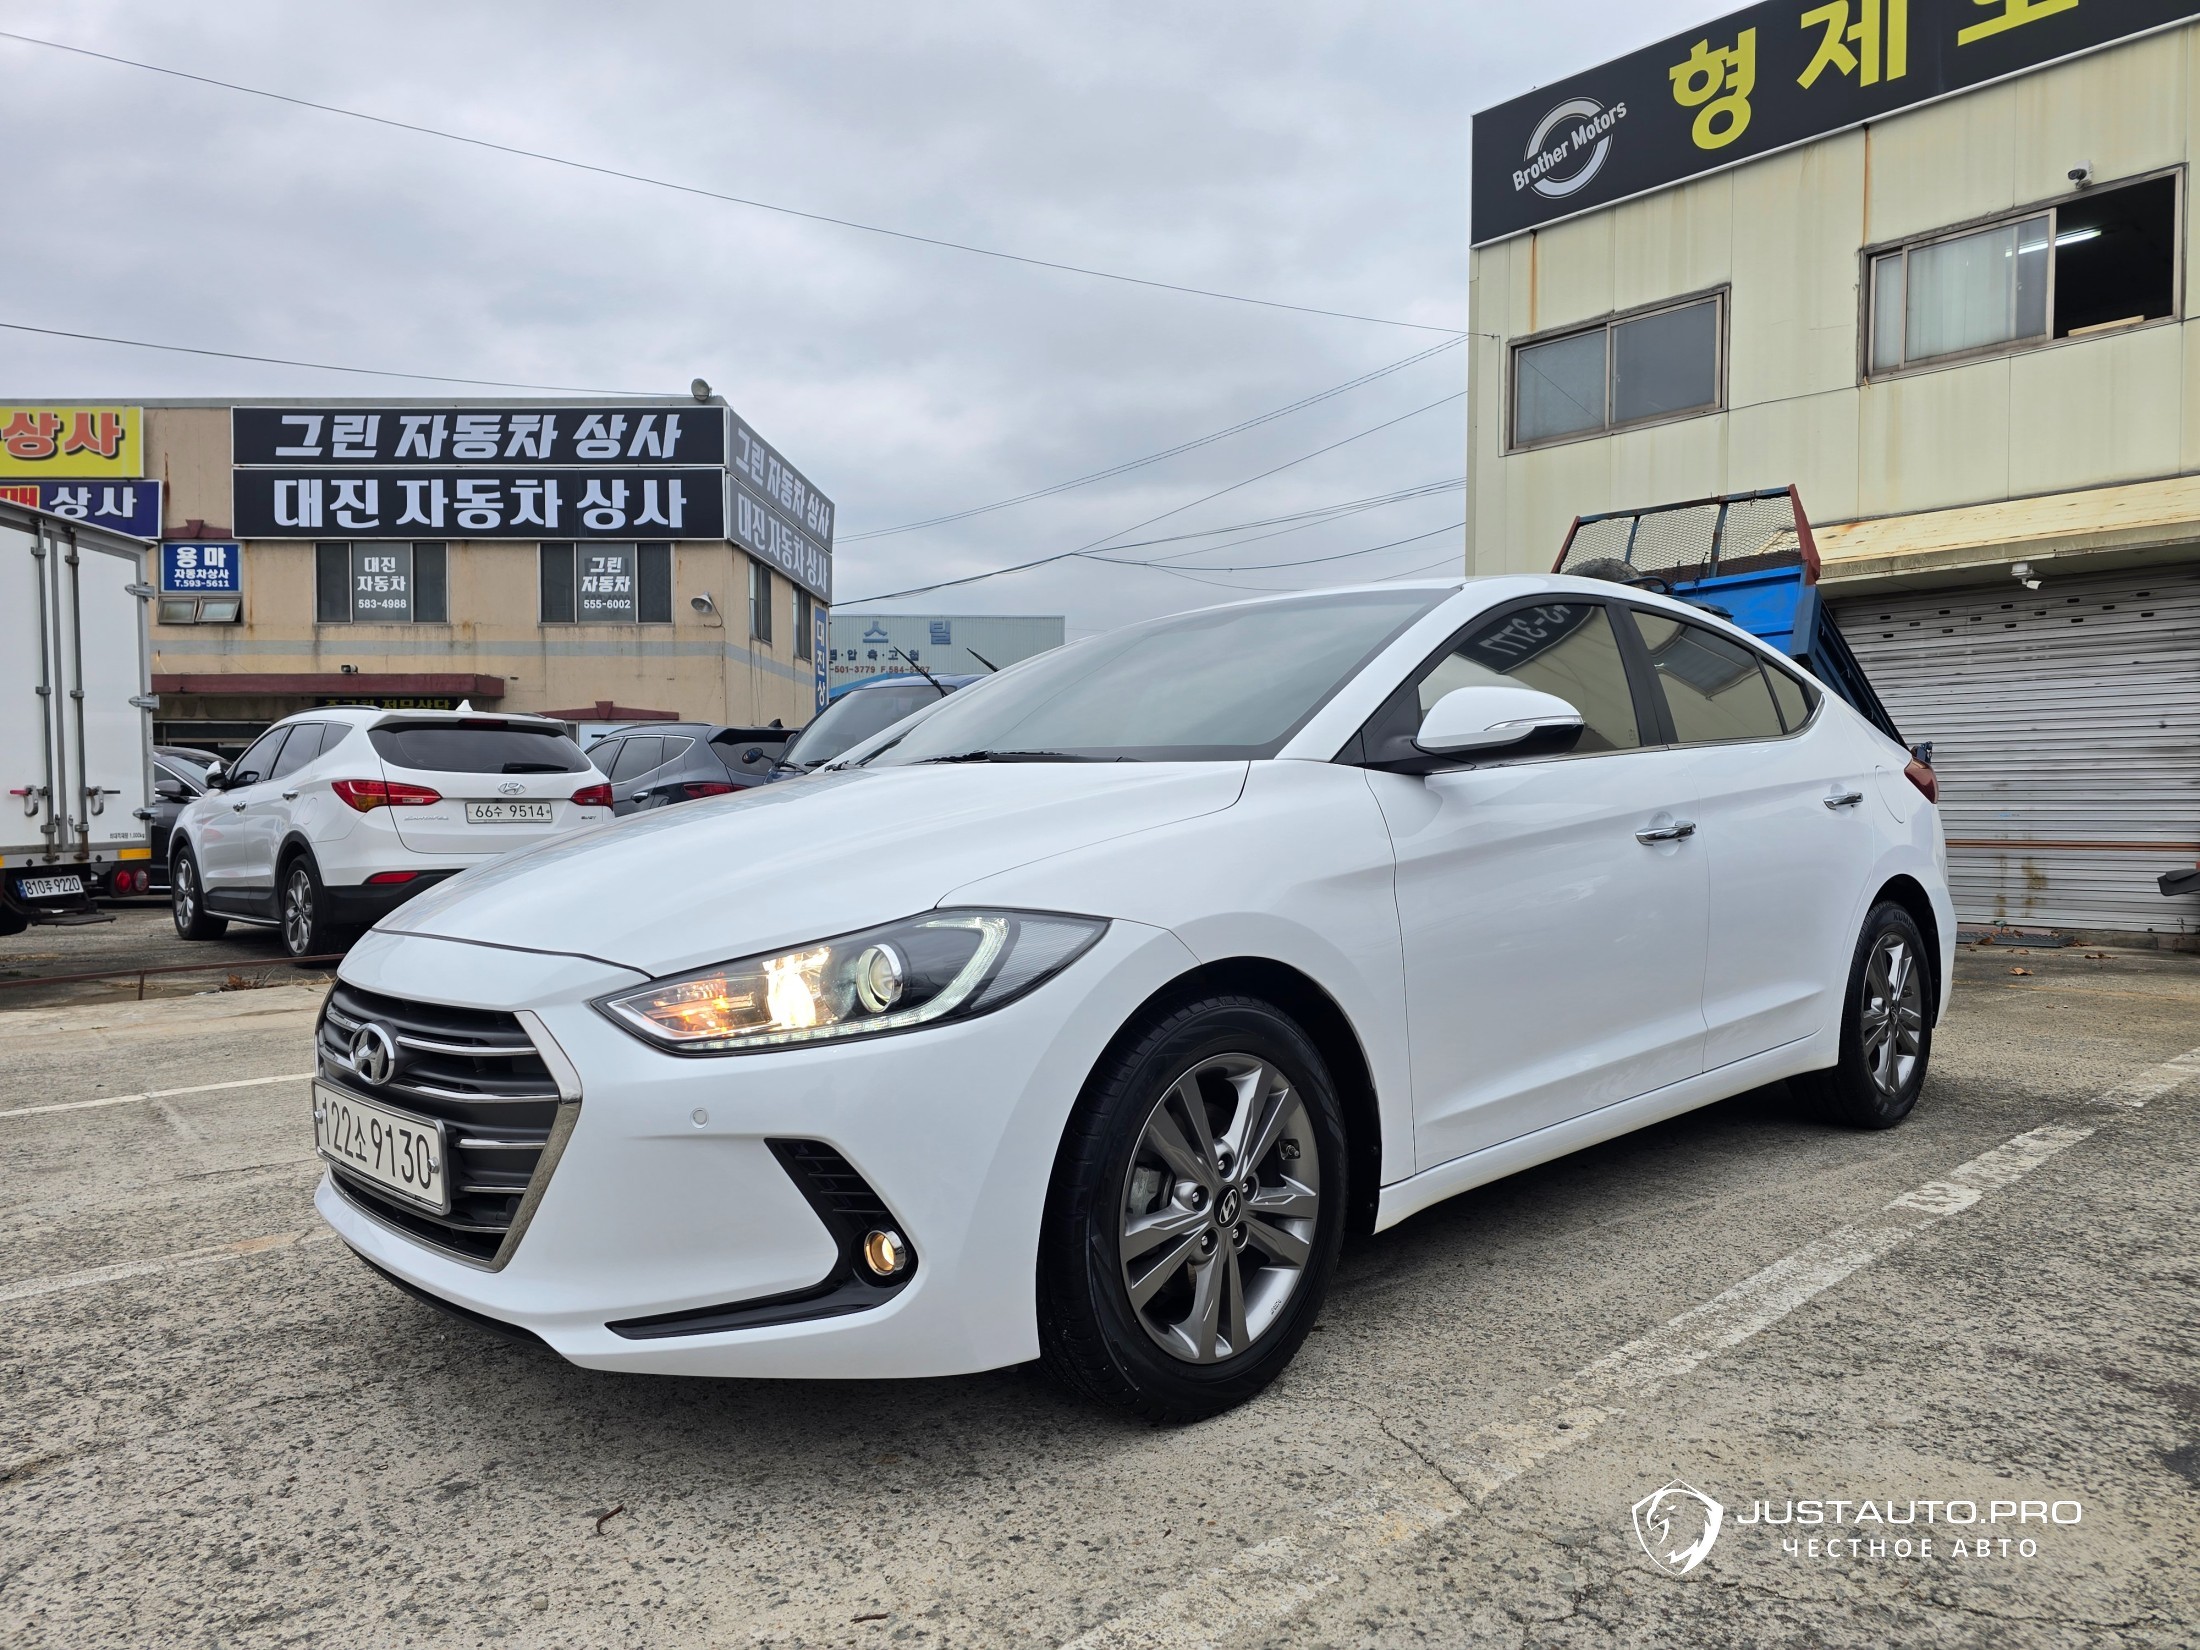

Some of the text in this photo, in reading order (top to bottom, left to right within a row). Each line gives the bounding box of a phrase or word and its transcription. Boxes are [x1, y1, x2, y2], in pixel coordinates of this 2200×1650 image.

[1512, 102, 1627, 192] Brother Motors
[1, 411, 123, 459] 상사
[275, 414, 682, 459] 그린 자동차 상사
[735, 427, 830, 540] 그린 자동차 상사
[50, 486, 138, 519] 상사
[274, 479, 687, 529] 대진 자동차 상사
[738, 492, 828, 593] 대진 자동차 상사
[364, 556, 396, 573] 대진
[590, 556, 622, 573] 그린
[174, 568, 230, 579] 자동차상사
[174, 579, 230, 588] T.593-5611
[357, 575, 406, 592] 자동차
[581, 575, 631, 592] 자동차
[358, 598, 407, 609] 583-4988
[583, 599, 631, 609] 555-6002
[475, 804, 545, 818] 66수 9514
[54, 876, 80, 892] 9220
